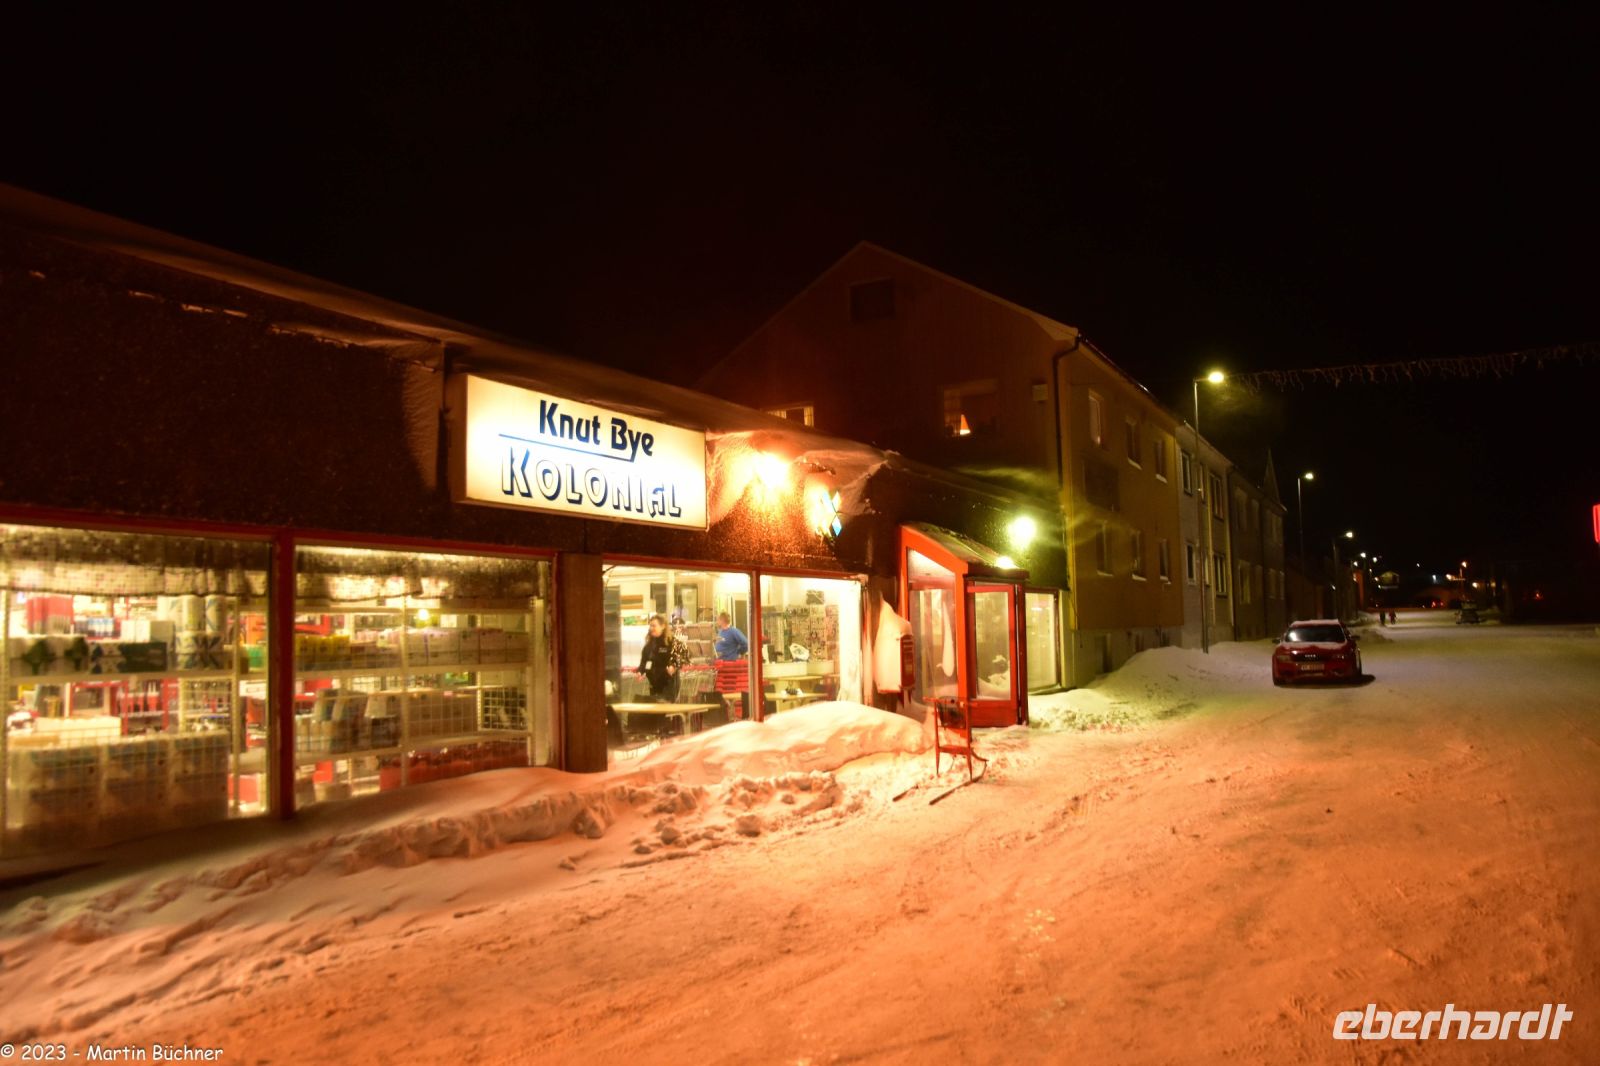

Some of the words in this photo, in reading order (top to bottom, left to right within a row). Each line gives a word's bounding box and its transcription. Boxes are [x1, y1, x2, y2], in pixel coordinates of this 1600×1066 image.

[539, 399, 601, 446] Knut
[611, 417, 655, 463] Bye
[501, 446, 682, 518] KOLONIAL
